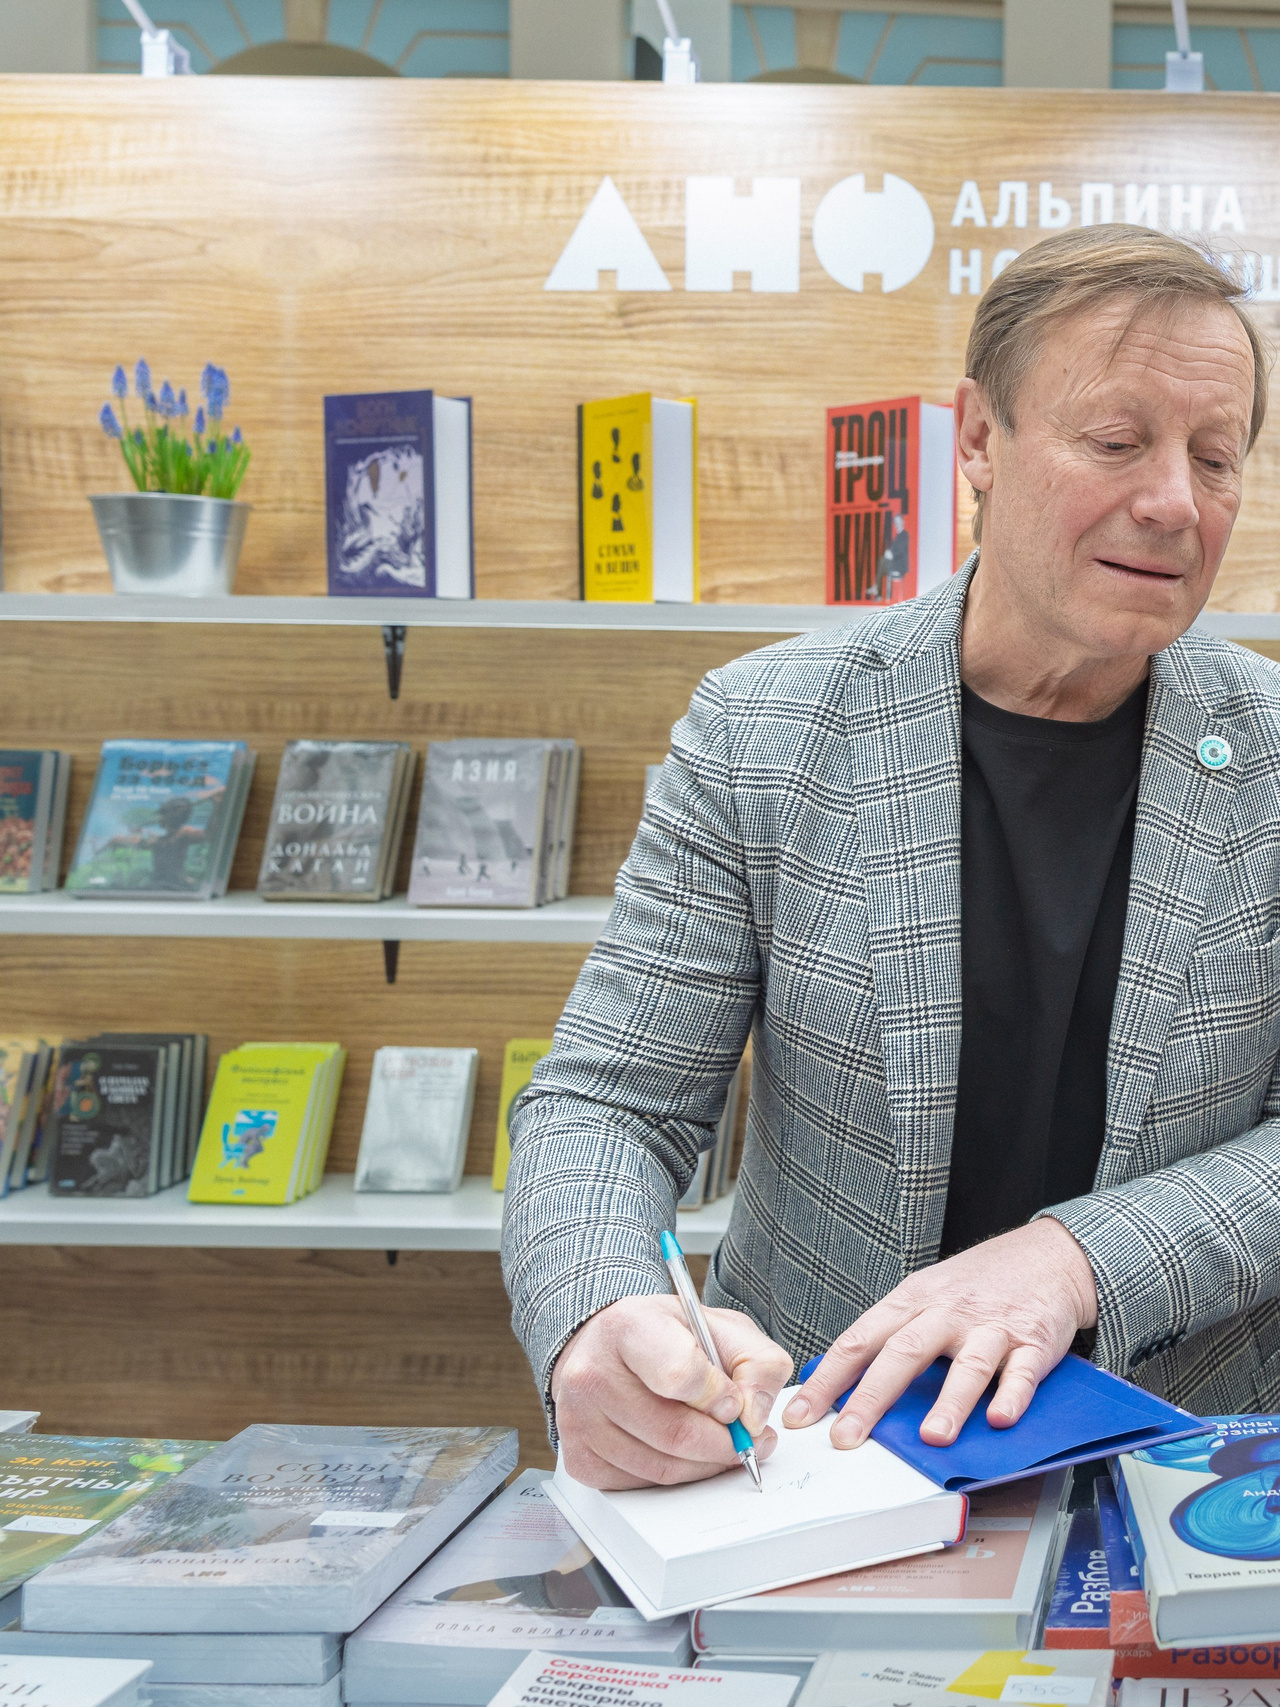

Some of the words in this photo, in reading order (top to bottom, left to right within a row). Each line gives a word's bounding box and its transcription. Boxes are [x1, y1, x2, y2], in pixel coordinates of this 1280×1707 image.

[950, 180, 1246, 232] АЛЬПИНА
[451, 759, 518, 782] АЗИЯ
[278, 801, 378, 825] ВОЙНА
[9, 1457, 46, 1466] ЭД
[51, 1457, 119, 1468] ЙОНГ
[276, 1463, 391, 1473] СОВЫ
[0, 1474, 155, 1492] ЪЯТНЫЙ
[221, 1474, 276, 1483] ВО
[0, 1488, 49, 1500] ИР
[0, 1509, 85, 1519] ЕАЛЬНОСТЬ
[5, 1502, 83, 1511] ОЩУЩАЮТ
[1185, 1569, 1242, 1580] Теория
[435, 1622, 496, 1634] ОЛЬГА
[512, 1626, 616, 1638] ФИЛАТОВА
[541, 1667, 671, 1690] персонажа
[549, 1658, 660, 1679] Создание
[668, 1673, 723, 1684] арки
[535, 1674, 635, 1697] Секреты
[872, 1673, 903, 1684] Крис
[906, 1679, 940, 1690] Смит
[520, 1694, 608, 1707] масте
[527, 1685, 664, 1707] сценарного
